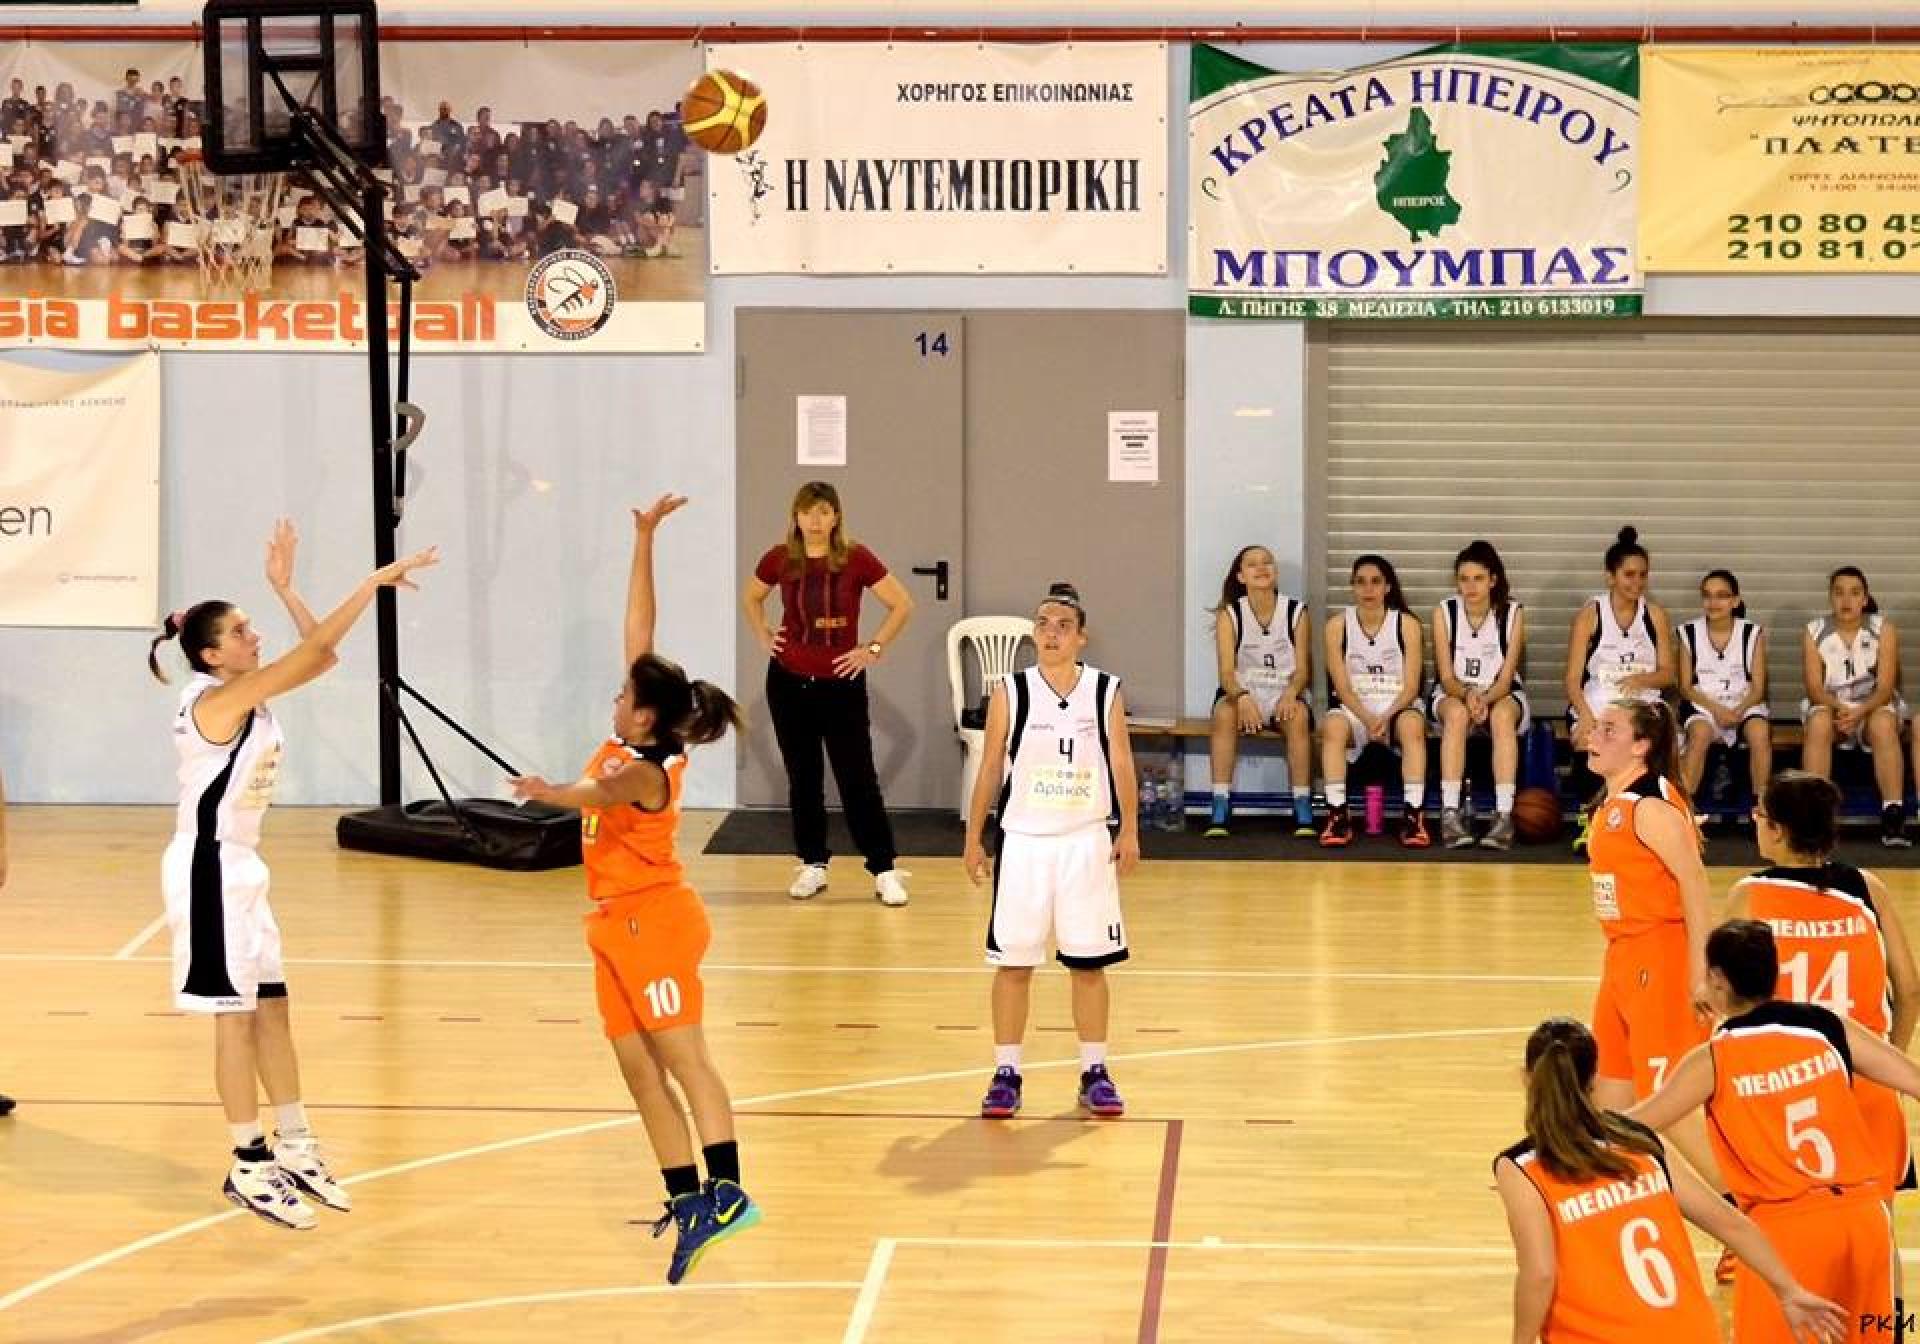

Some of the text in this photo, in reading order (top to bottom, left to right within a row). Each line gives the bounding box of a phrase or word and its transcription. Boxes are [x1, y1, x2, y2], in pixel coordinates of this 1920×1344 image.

[897, 82, 1133, 103] ΧΟΡΗΓΟΣ ΕΠΙΚΟΙΝΩΝΙΑΣ
[1210, 69, 1630, 176] ΚΡΕΑΤΑ ΗΠΕΙΡΟΥ
[785, 159, 1141, 212] Η ΝΑΥΤΕΜΠΟΡΙΚΗ
[1392, 195, 1446, 206] ΗΠΕΙΡΟΣ
[1727, 214, 1802, 233] 210
[1818, 214, 1867, 233] 80
[1727, 240, 1802, 259] 210
[1818, 240, 1865, 259] 81
[1213, 248, 1630, 288] ΜΠΟΥΜΠΑΣ
[0, 290, 79, 338] sia
[1241, 301, 1306, 317] ΠΗΓΗΣ
[1315, 302, 1338, 318] 38
[1349, 301, 1438, 317] ΜΕΛΙΣΣΙΑ
[1500, 300, 1534, 315] 210
[1538, 299, 1616, 315] 6133019
[914, 332, 949, 356] 14
[0, 505, 52, 537] en
[1059, 738, 1074, 764] 4
[1108, 923, 1121, 946] 4
[644, 976, 681, 1018] 10
[1779, 951, 1855, 1019] 14
[1648, 1057, 1668, 1091] 7
[1785, 1097, 1836, 1180] 5
[1619, 1217, 1678, 1309] 6
